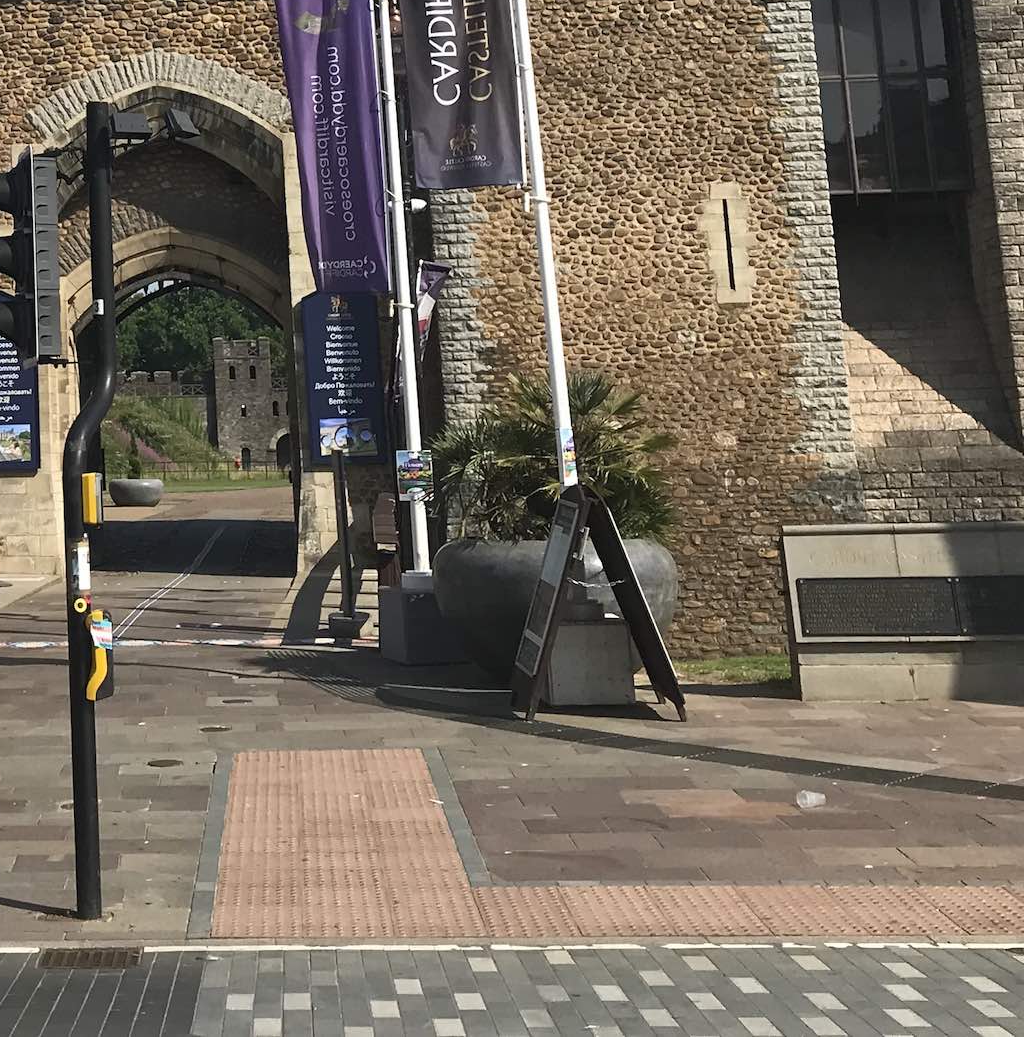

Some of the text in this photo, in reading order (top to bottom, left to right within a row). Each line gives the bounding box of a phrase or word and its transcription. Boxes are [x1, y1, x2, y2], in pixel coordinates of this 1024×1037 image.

[326, 324, 355, 332] Welcome
[325, 341, 359, 349] Bienvenue
[323, 357, 362, 365] Willkommen
[328, 397, 364, 405] Bem-vindo
